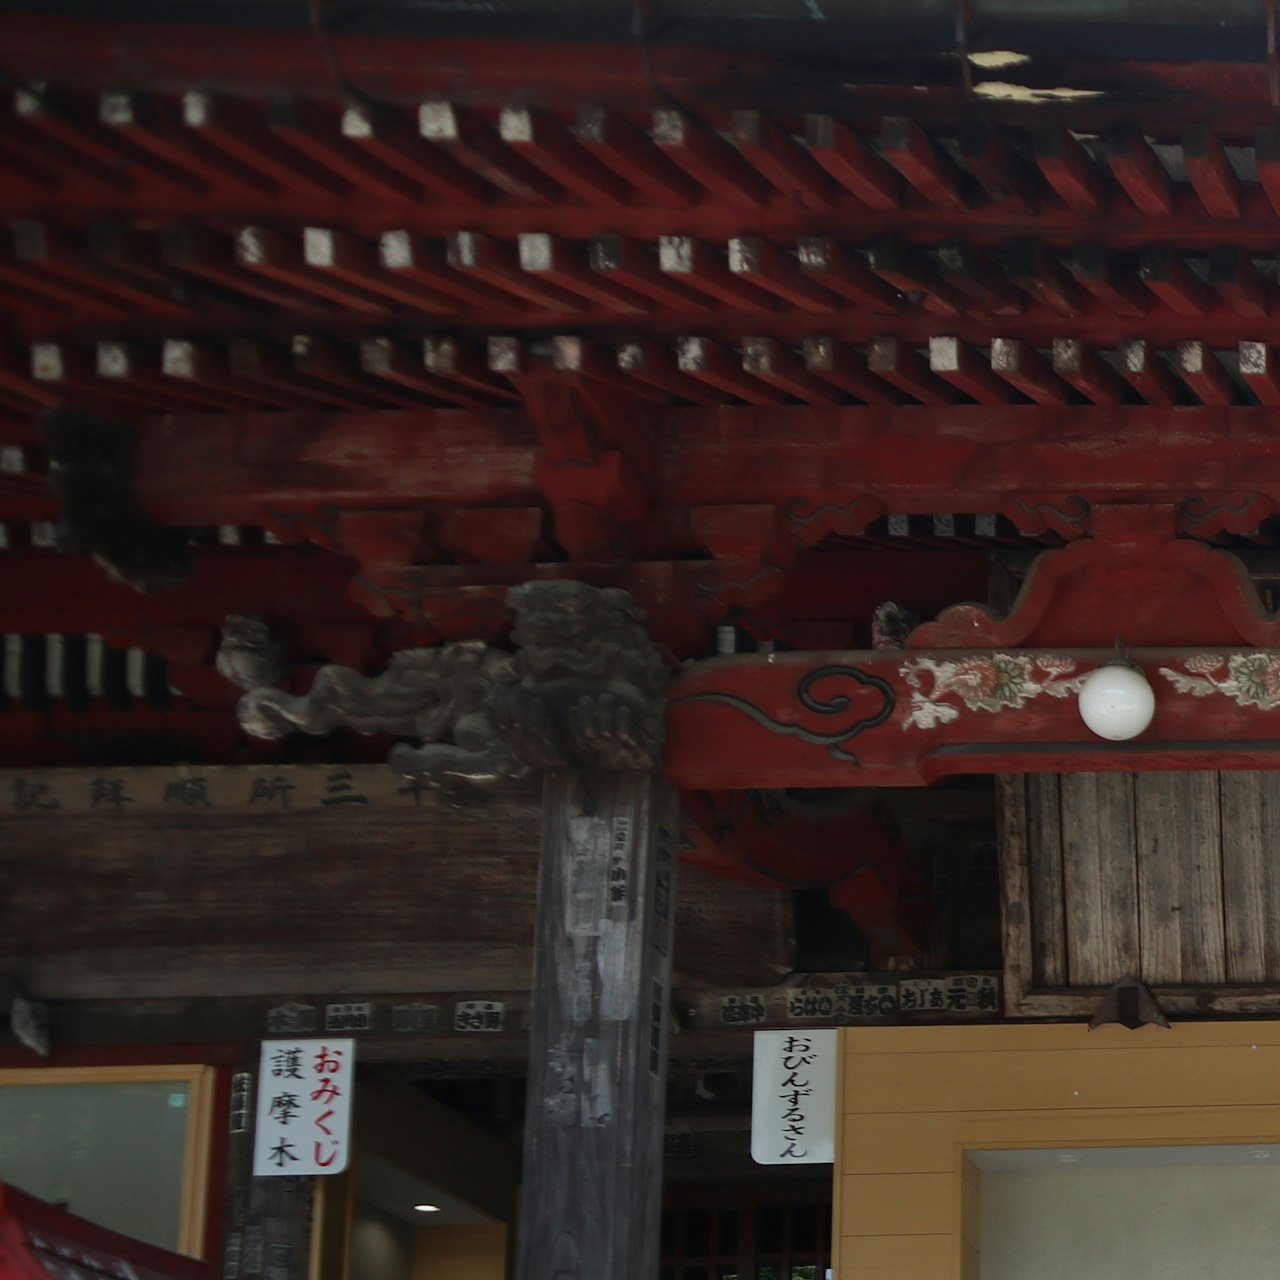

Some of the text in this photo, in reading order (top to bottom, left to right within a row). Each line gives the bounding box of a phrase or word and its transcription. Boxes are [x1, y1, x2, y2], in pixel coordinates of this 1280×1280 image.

[267, 1047, 306, 1168] 護摩木
[310, 1046, 343, 1167] おみくじ
[780, 1034, 813, 1161] おびんずるさん
